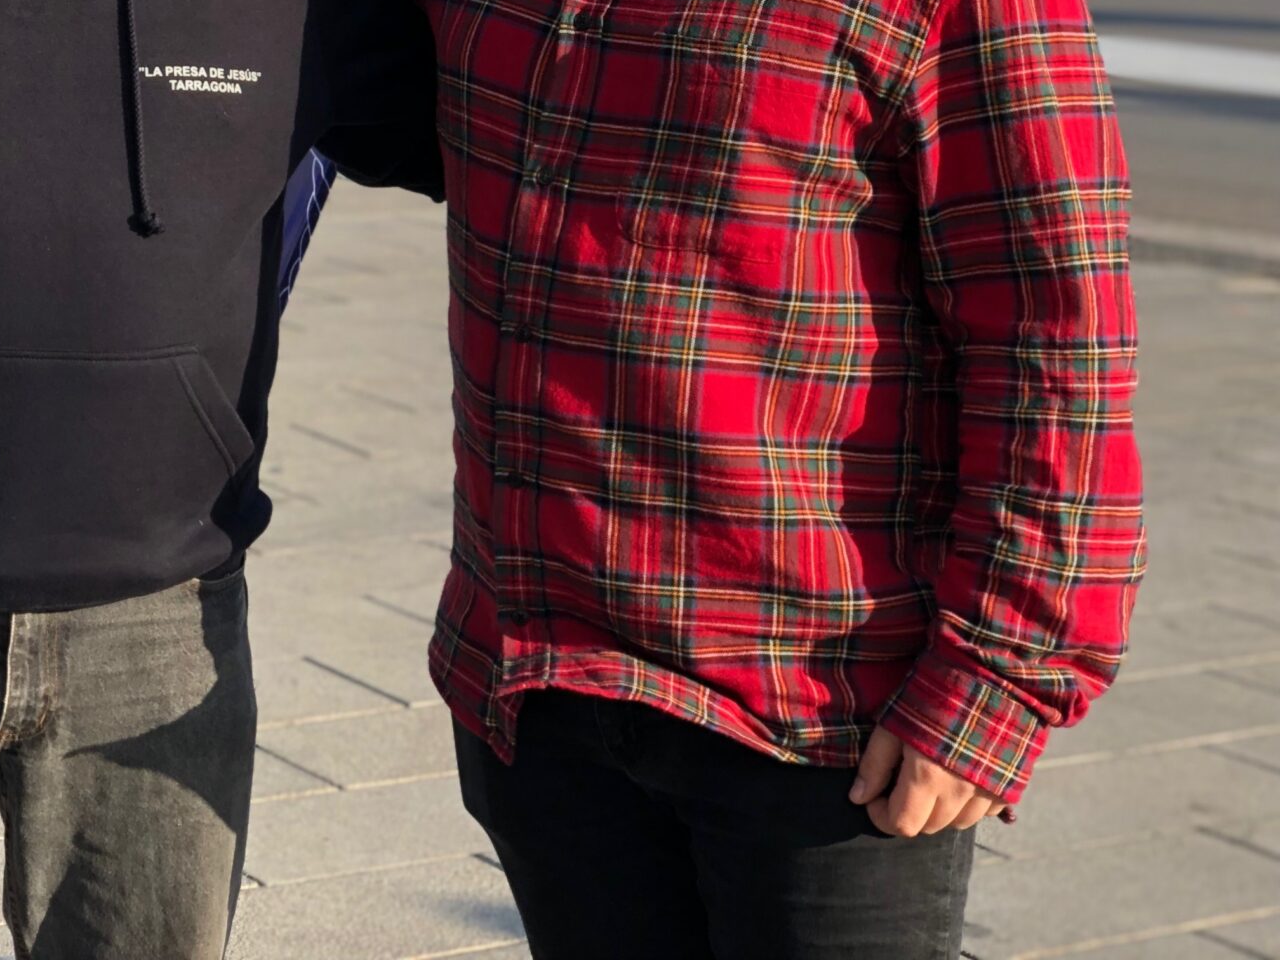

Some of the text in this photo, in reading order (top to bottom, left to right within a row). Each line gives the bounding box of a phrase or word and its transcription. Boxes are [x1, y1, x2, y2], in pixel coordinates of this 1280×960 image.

[165, 66, 207, 78] PRESA
[209, 67, 225, 79] DE
[169, 80, 242, 94] TARRAGONA
